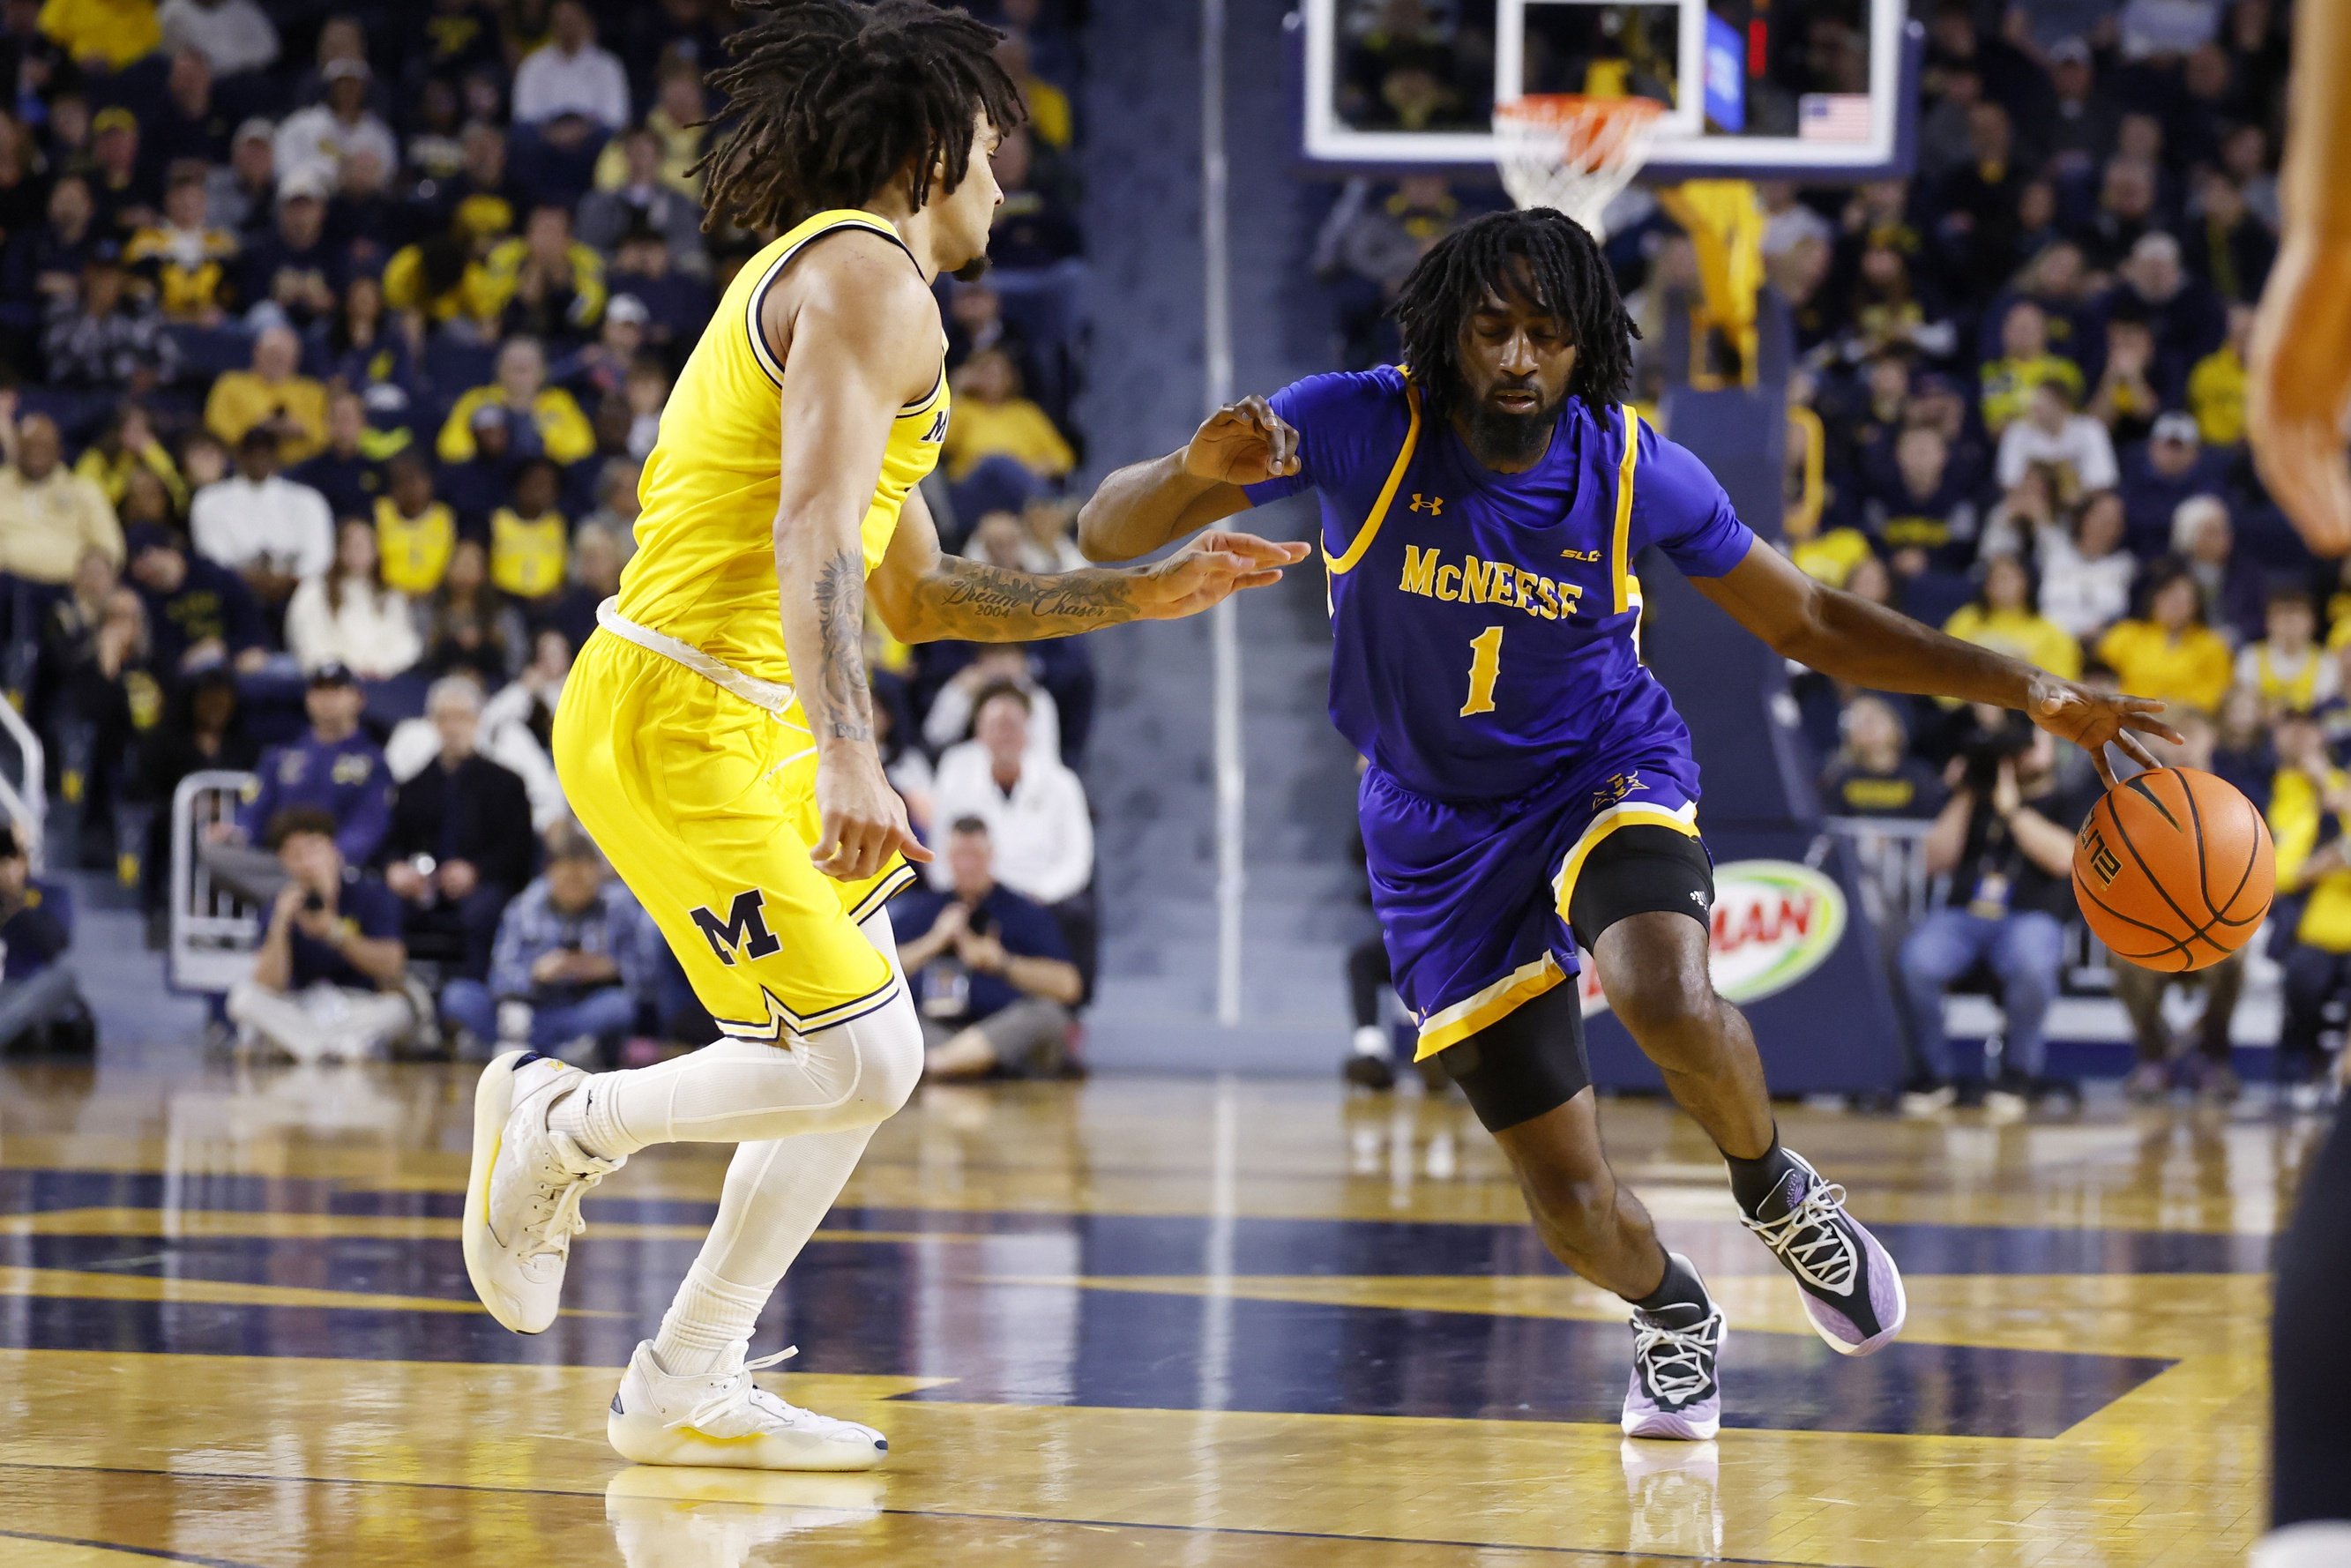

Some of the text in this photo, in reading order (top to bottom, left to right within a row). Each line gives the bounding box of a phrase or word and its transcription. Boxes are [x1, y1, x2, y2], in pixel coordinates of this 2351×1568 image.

[942, 579, 1108, 617] Dream Chaser
[974, 604, 1011, 619] 2004
[1459, 625, 1504, 718] 1
[688, 887, 783, 967] M
